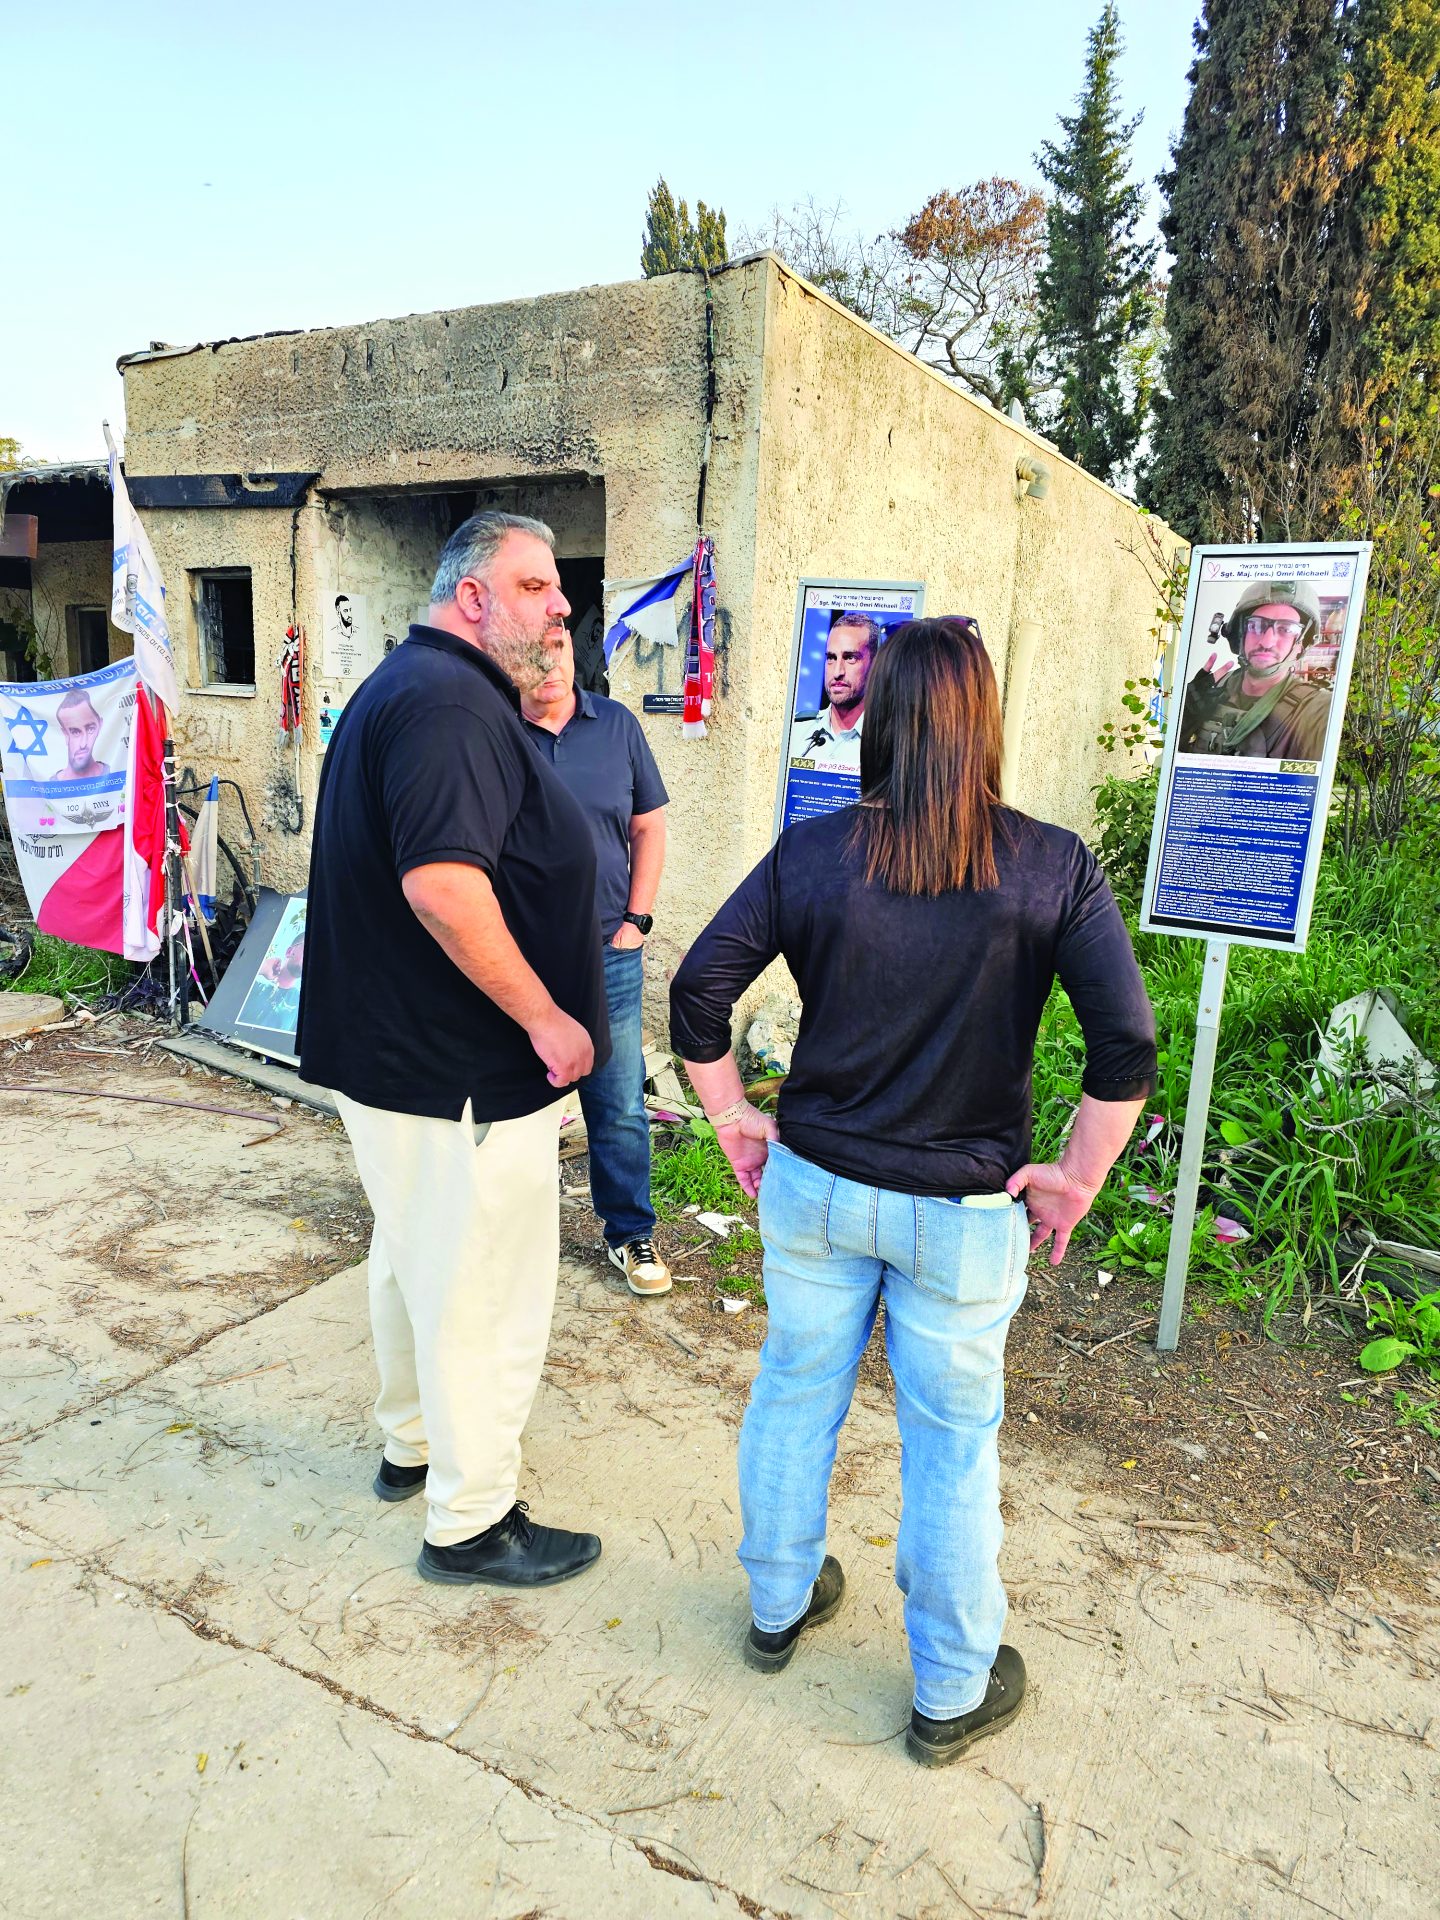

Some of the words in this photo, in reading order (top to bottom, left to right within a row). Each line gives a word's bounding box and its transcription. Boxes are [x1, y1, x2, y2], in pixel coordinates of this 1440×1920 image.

[1236, 570, 1252, 578] Maj.
[1254, 570, 1274, 578] (res.)
[67, 804, 79, 812] 100
[93, 800, 110, 810] צוות
